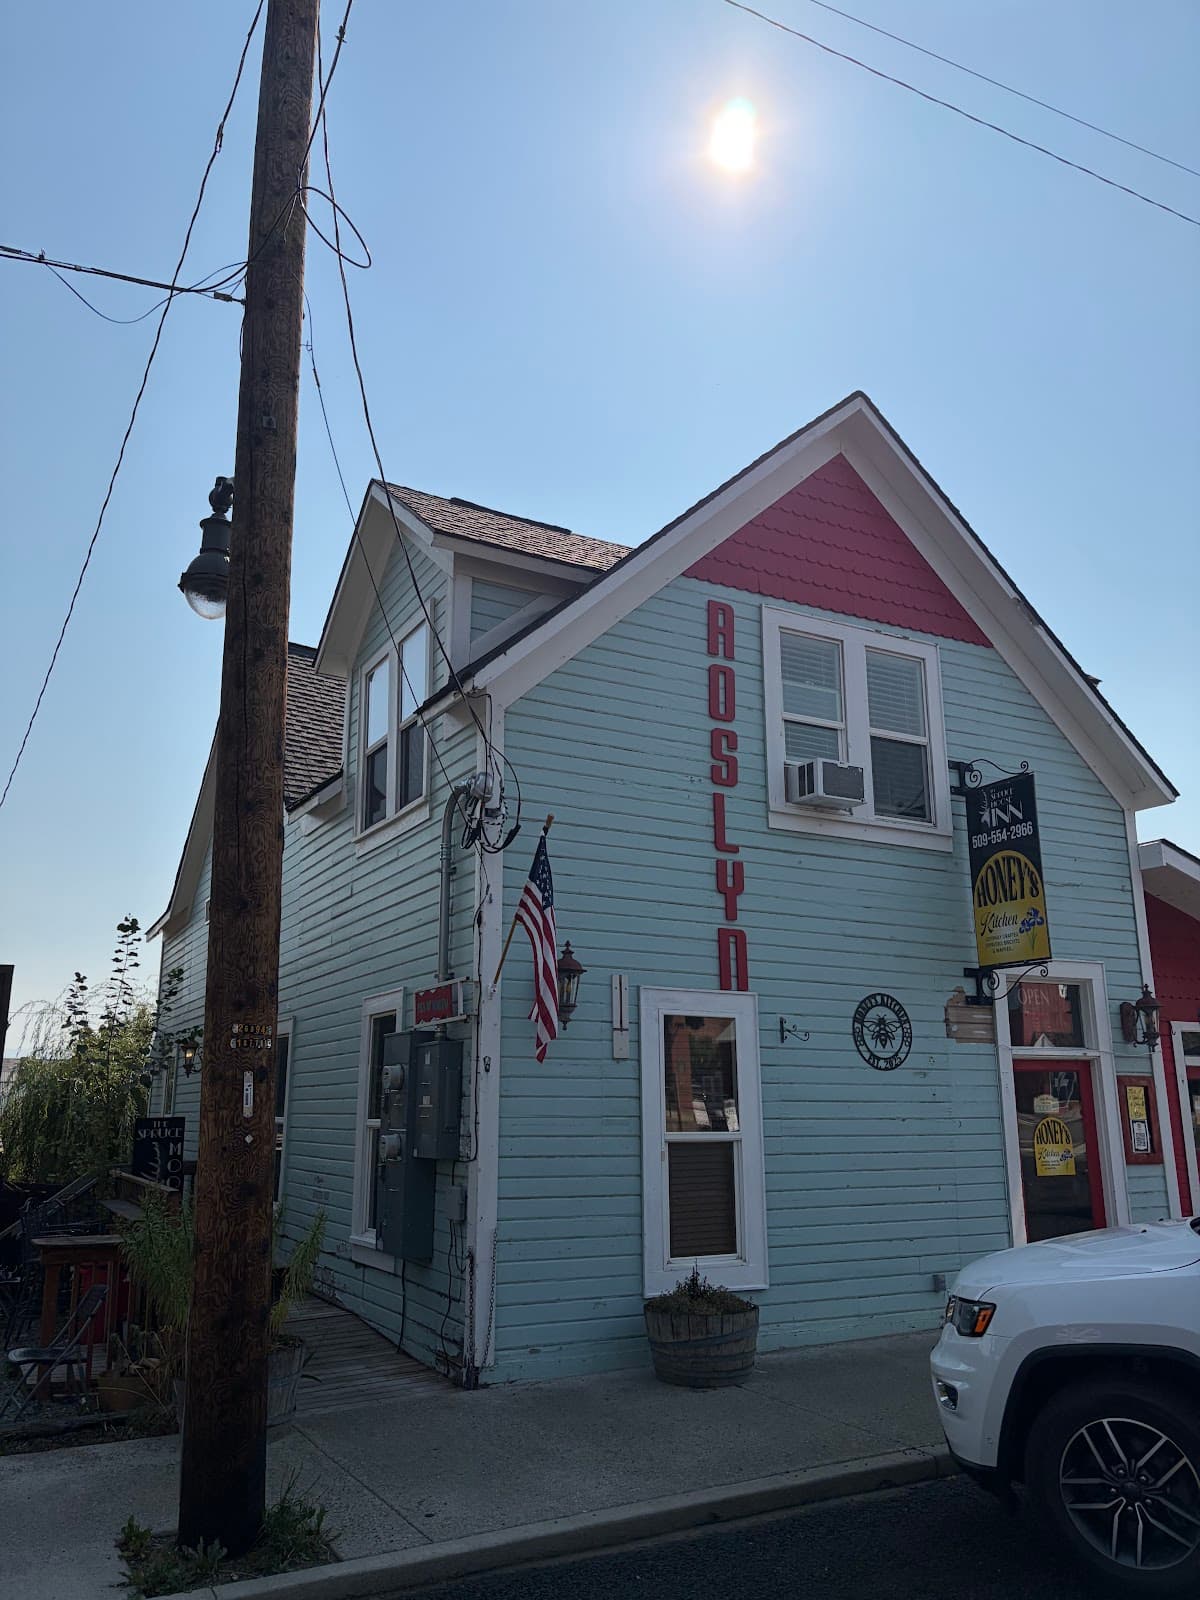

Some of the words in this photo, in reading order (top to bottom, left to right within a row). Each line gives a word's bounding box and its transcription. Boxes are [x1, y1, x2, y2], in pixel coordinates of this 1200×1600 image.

[707, 599, 749, 991] ROSLYN
[990, 799, 1024, 828] INN
[977, 855, 1040, 908] HONEY'S
[980, 911, 1018, 937] Kitchen
[1018, 988, 1050, 1006] OPEN
[136, 1127, 183, 1141] SPRUCE
[1036, 1119, 1071, 1145] HONEY'S
